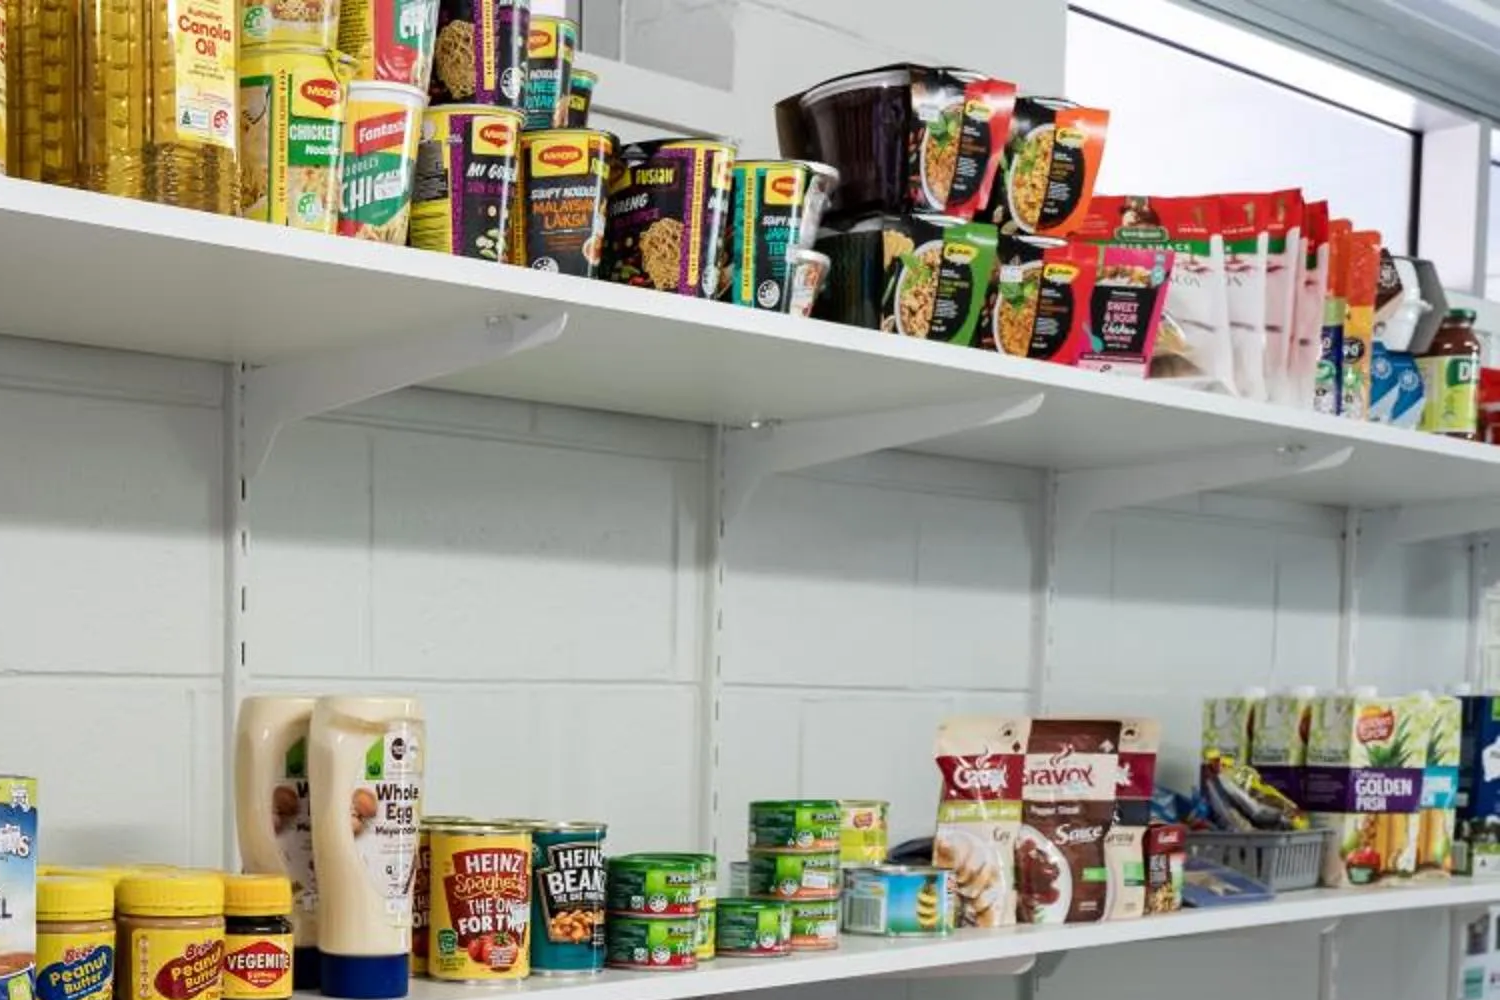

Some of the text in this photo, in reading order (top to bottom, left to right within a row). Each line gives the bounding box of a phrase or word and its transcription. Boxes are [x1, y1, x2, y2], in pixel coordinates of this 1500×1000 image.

[178, 15, 231, 42] Canola
[195, 39, 217, 57] Oil
[543, 214, 589, 229] LAKSA
[1022, 764, 1095, 786] ravox
[376, 784, 419, 800] Whole
[1355, 778, 1412, 796] GOLDEN
[386, 802, 412, 823] Egg
[1055, 823, 1103, 846] Sauce
[465, 852, 522, 874] HEINZ
[468, 898, 494, 914] THE
[458, 917, 494, 935] FOR
[50, 955, 107, 986] Peanut
[227, 955, 290, 970] VEGEMITE
[64, 972, 102, 995] Butter
